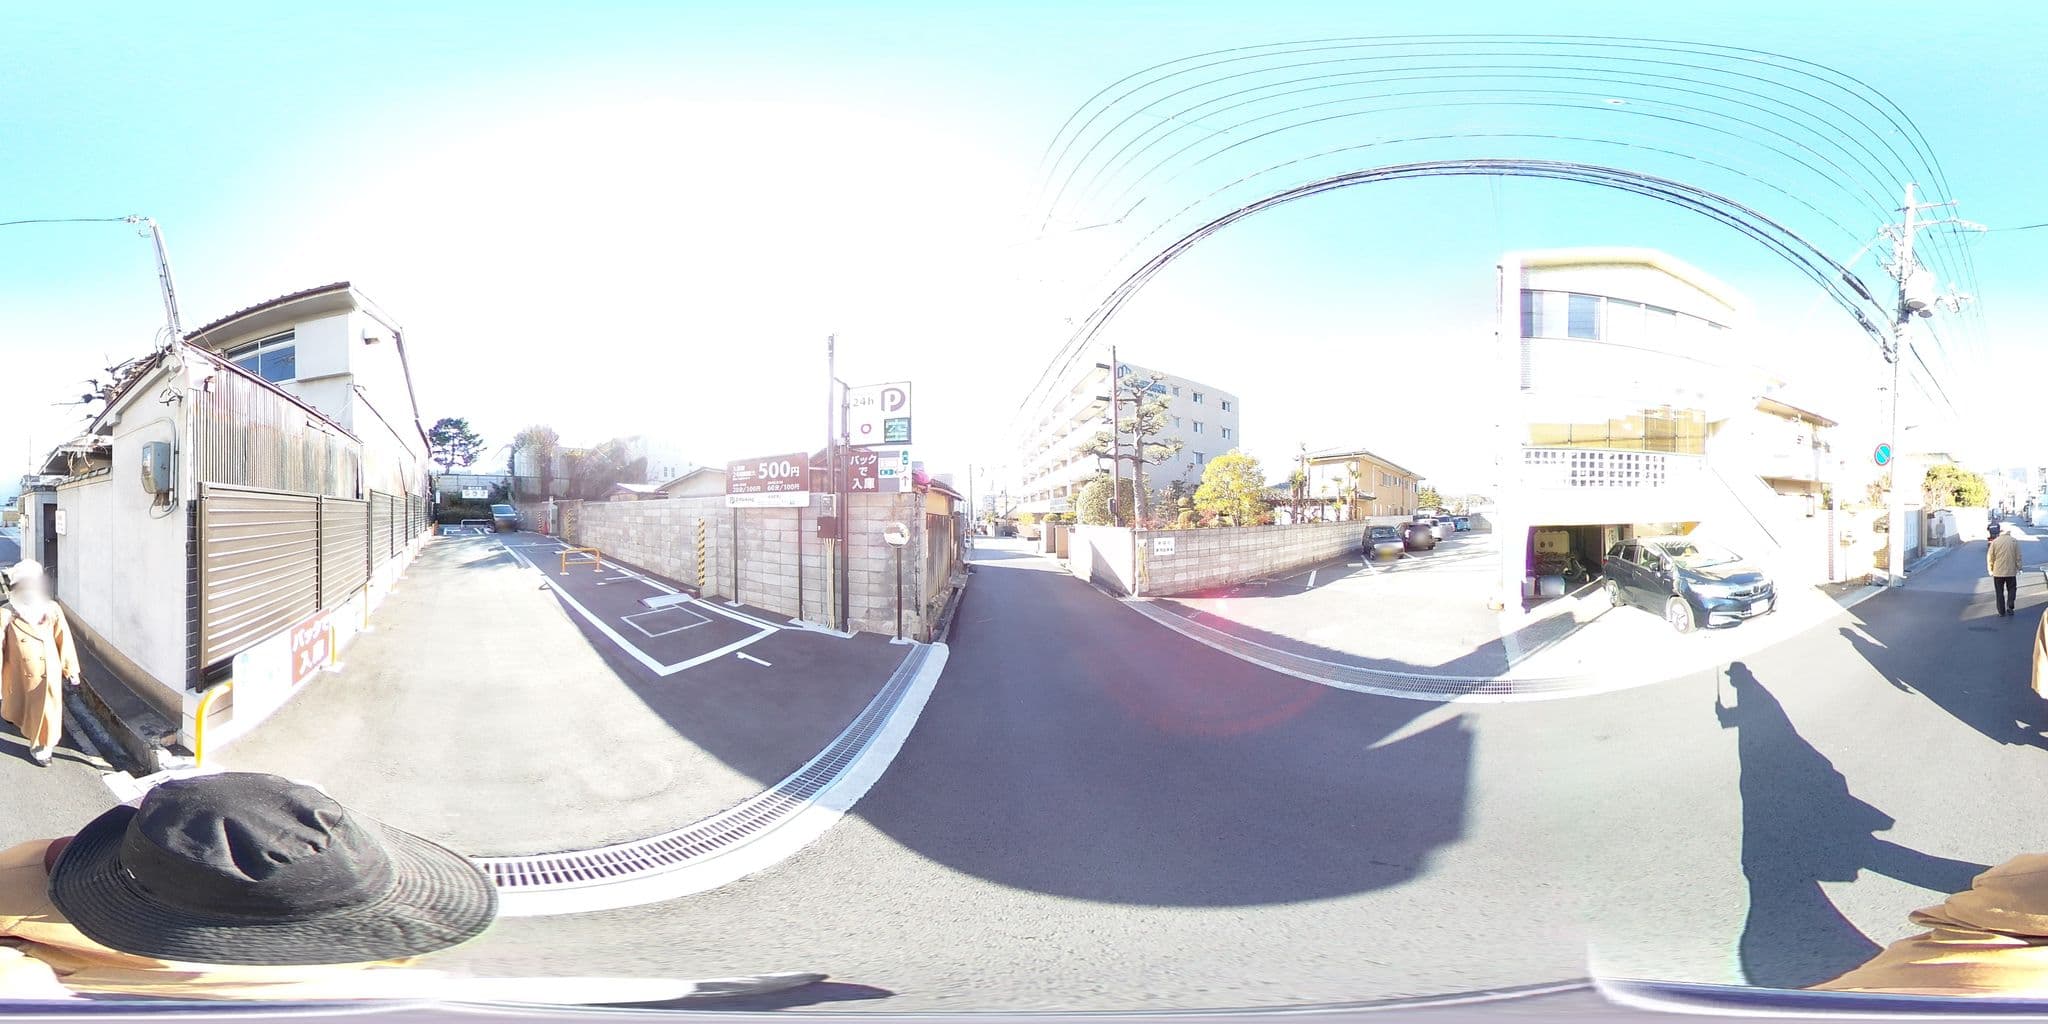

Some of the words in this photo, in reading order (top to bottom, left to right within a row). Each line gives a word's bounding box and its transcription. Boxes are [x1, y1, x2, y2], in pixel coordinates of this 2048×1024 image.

[853, 396, 874, 407] 24h
[881, 388, 905, 411] P
[850, 454, 877, 465] バック
[759, 460, 800, 479] 500円
[859, 466, 868, 476] で
[852, 477, 875, 490] 入庫
